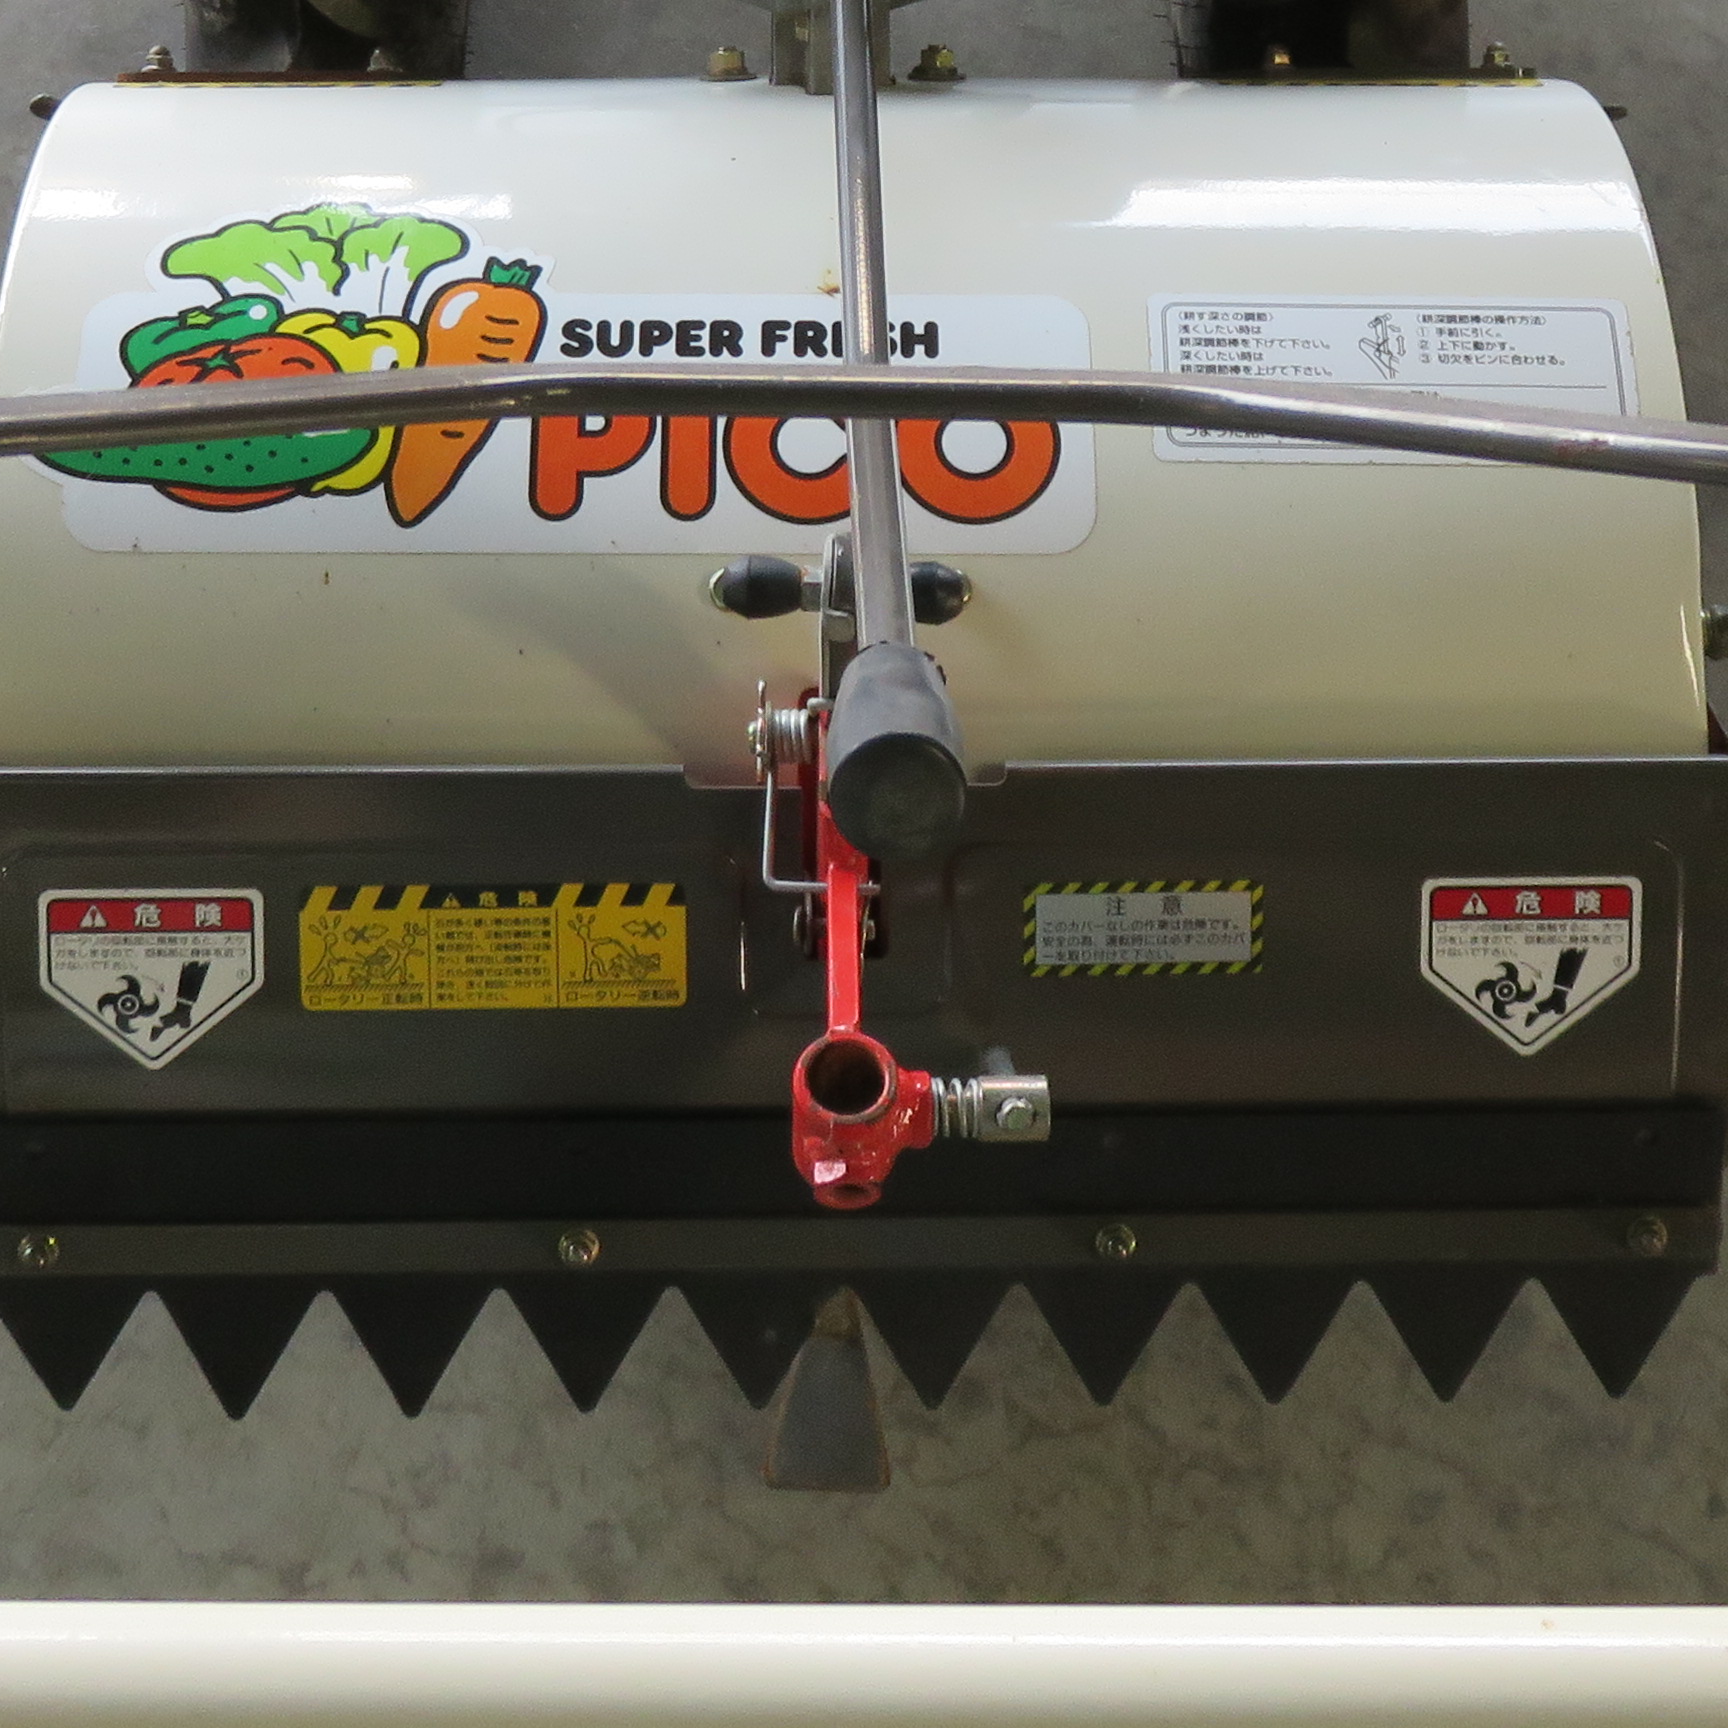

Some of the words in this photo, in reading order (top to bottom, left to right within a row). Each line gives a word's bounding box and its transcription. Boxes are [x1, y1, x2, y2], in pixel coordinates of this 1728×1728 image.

[559, 318, 744, 358] SUPER
[760, 319, 940, 359] FRH
[133, 902, 222, 928] 危険
[1105, 895, 1185, 917] 注意
[1515, 889, 1602, 915] 危険
